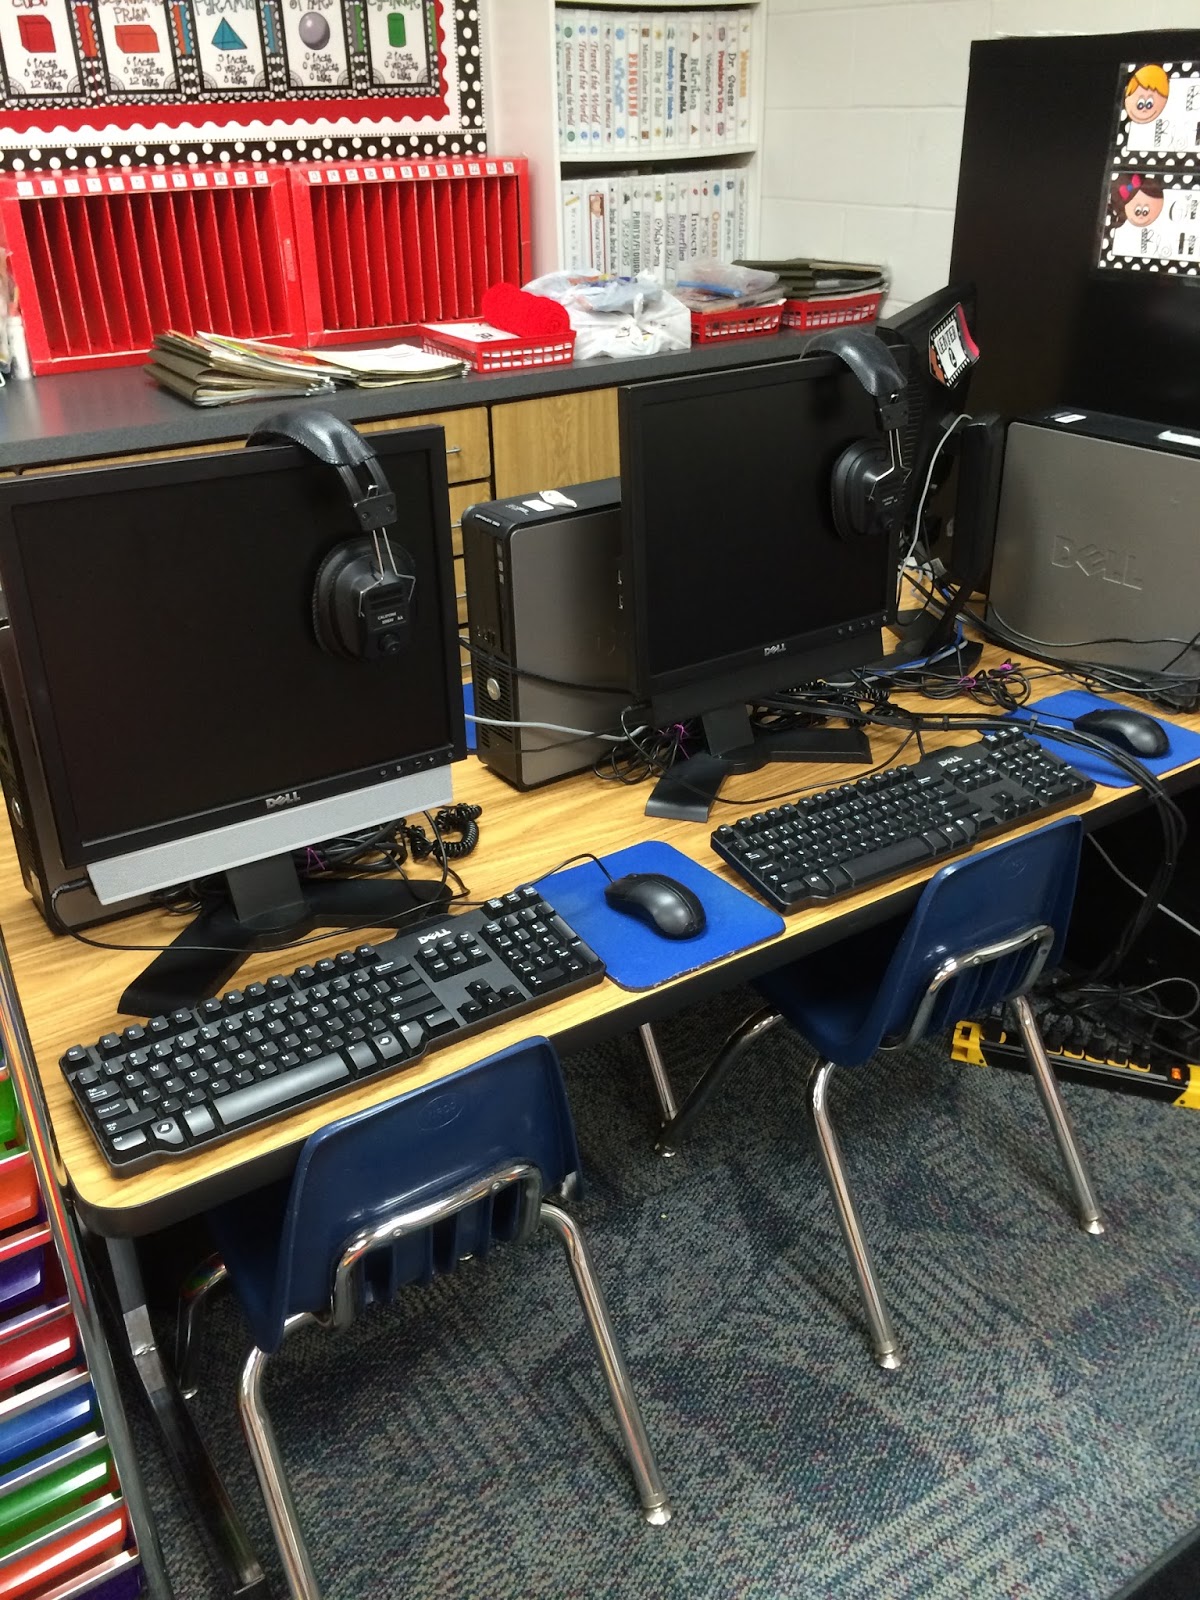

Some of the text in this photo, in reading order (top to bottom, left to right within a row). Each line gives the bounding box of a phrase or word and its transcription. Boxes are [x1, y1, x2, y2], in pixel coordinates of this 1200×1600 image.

[579, 41, 588, 123] Travel the World
[590, 41, 600, 124] Travel the World
[628, 53, 638, 117] PENGUINS
[679, 214, 687, 261] Butterflies
[691, 213, 699, 257] Insects
[712, 211, 720, 258] Ocean
[1051, 535, 1143, 591] DELL
[764, 643, 786, 656] DELL
[938, 756, 963, 767] DELL
[265, 791, 301, 809] DELL
[417, 928, 452, 944] DELL
